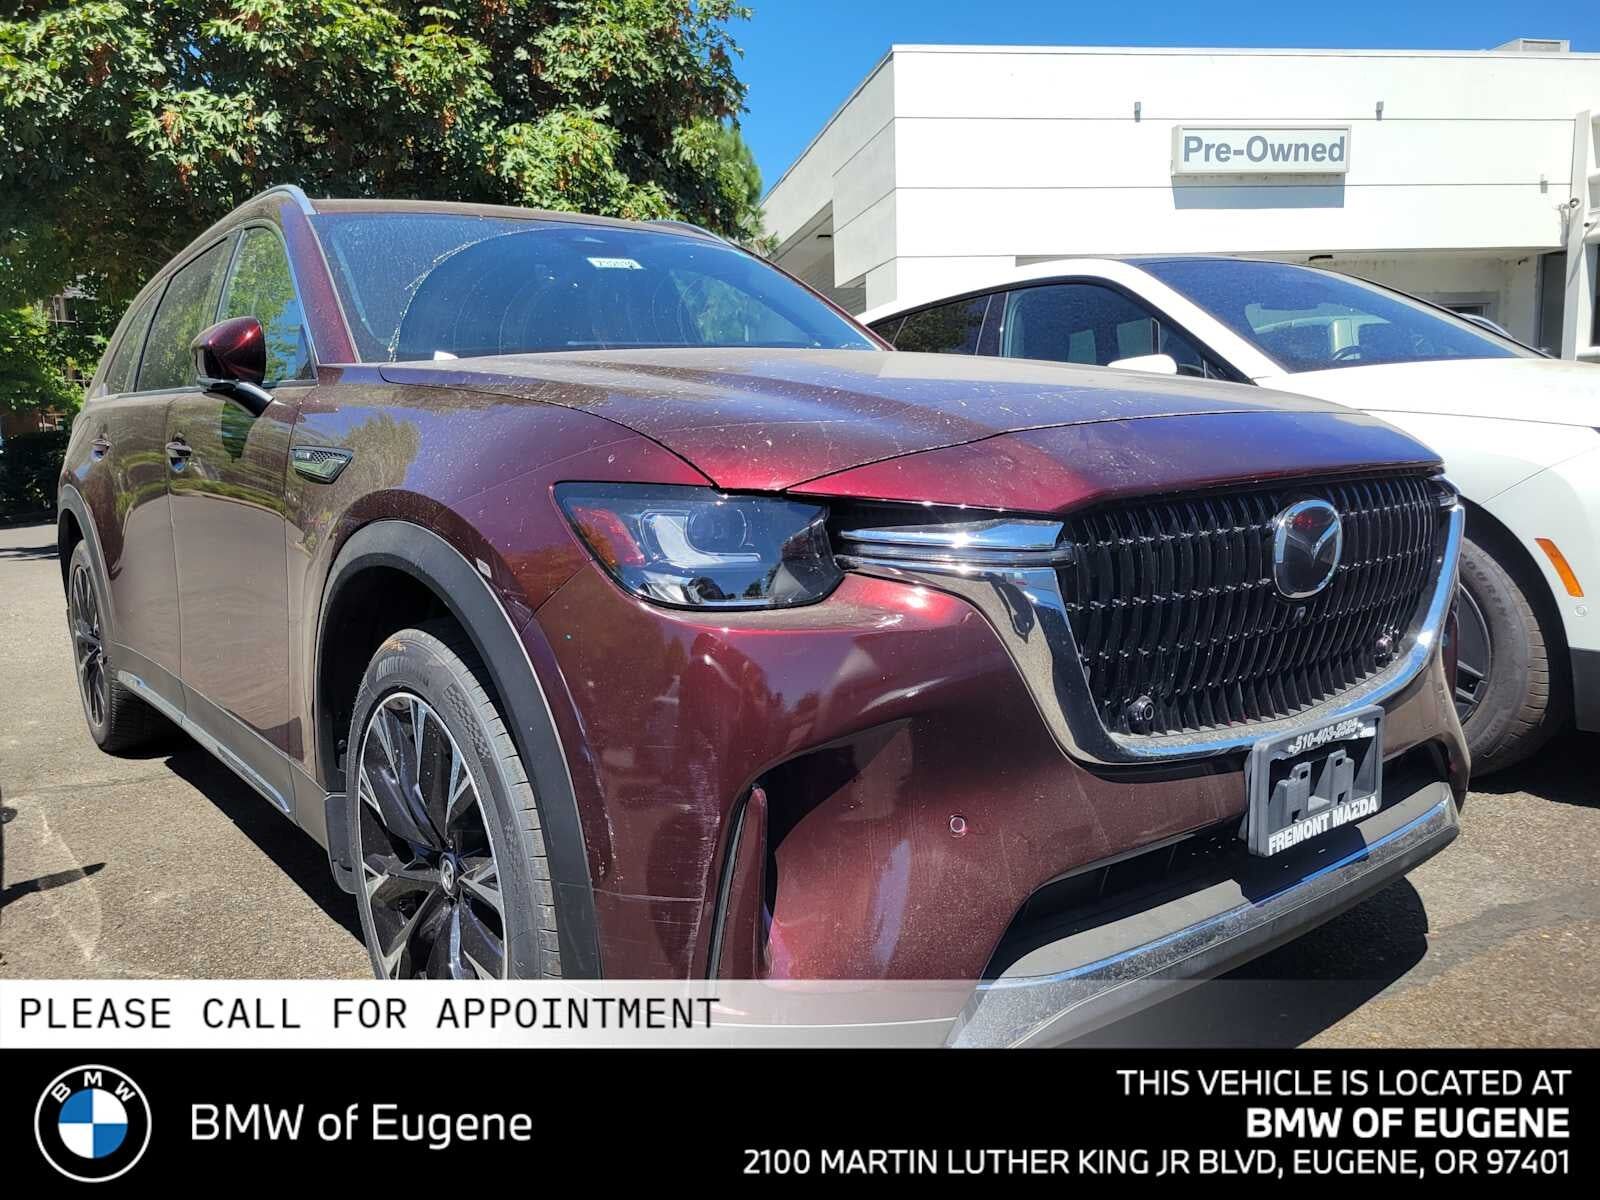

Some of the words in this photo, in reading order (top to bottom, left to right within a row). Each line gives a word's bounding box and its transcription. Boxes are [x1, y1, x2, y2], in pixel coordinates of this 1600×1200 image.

[1183, 135, 1345, 163] Pre-Owned
[1268, 812, 1330, 856] FREMONT
[1332, 796, 1378, 828] MAZDA
